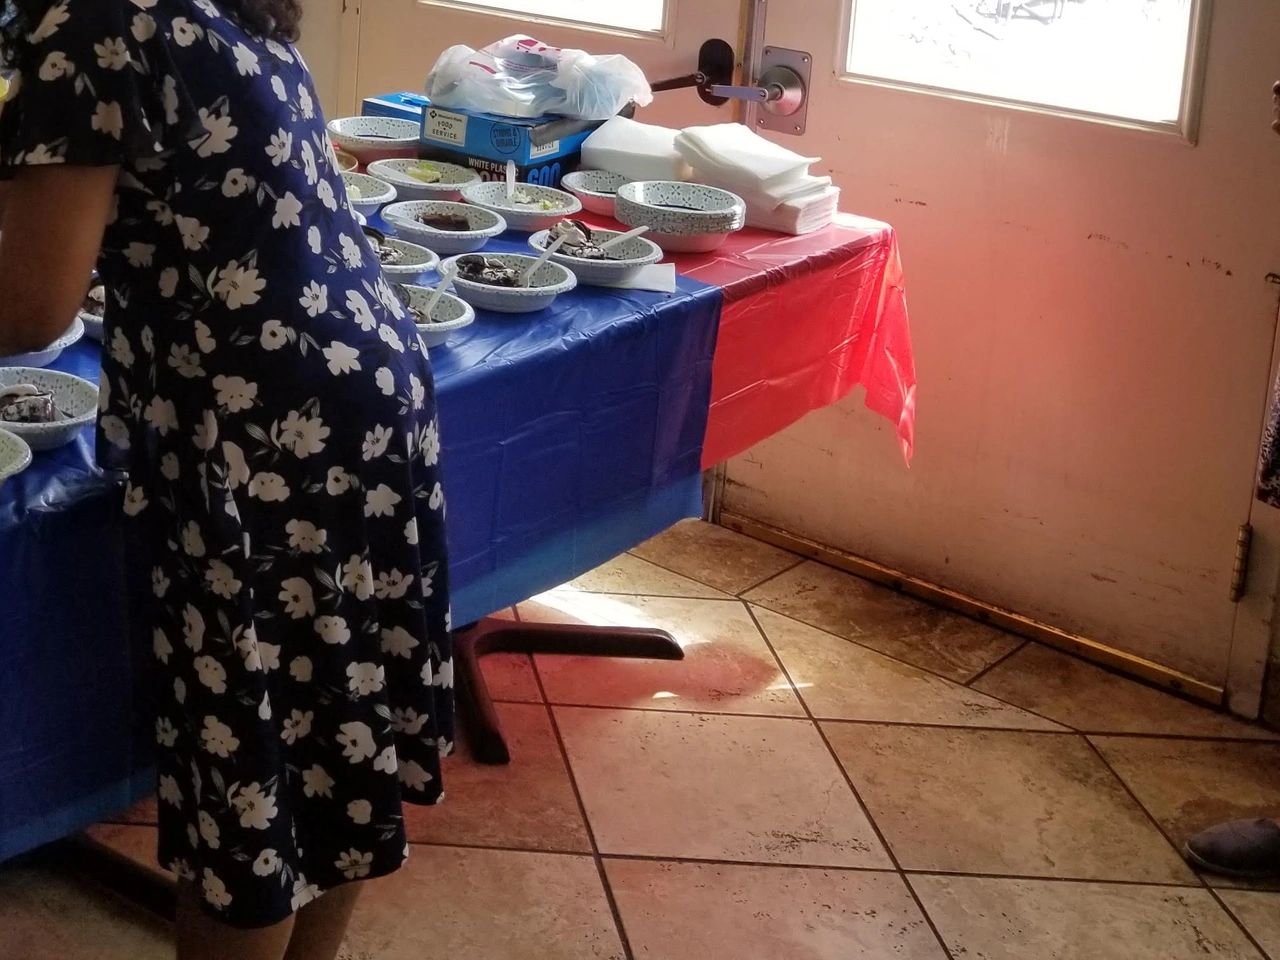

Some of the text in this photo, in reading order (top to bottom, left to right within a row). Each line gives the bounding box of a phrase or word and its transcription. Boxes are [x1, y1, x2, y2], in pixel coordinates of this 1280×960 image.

[432, 129, 457, 139] SERVICE
[468, 157, 489, 169] WHITE
[490, 162, 519, 177] PLASC
